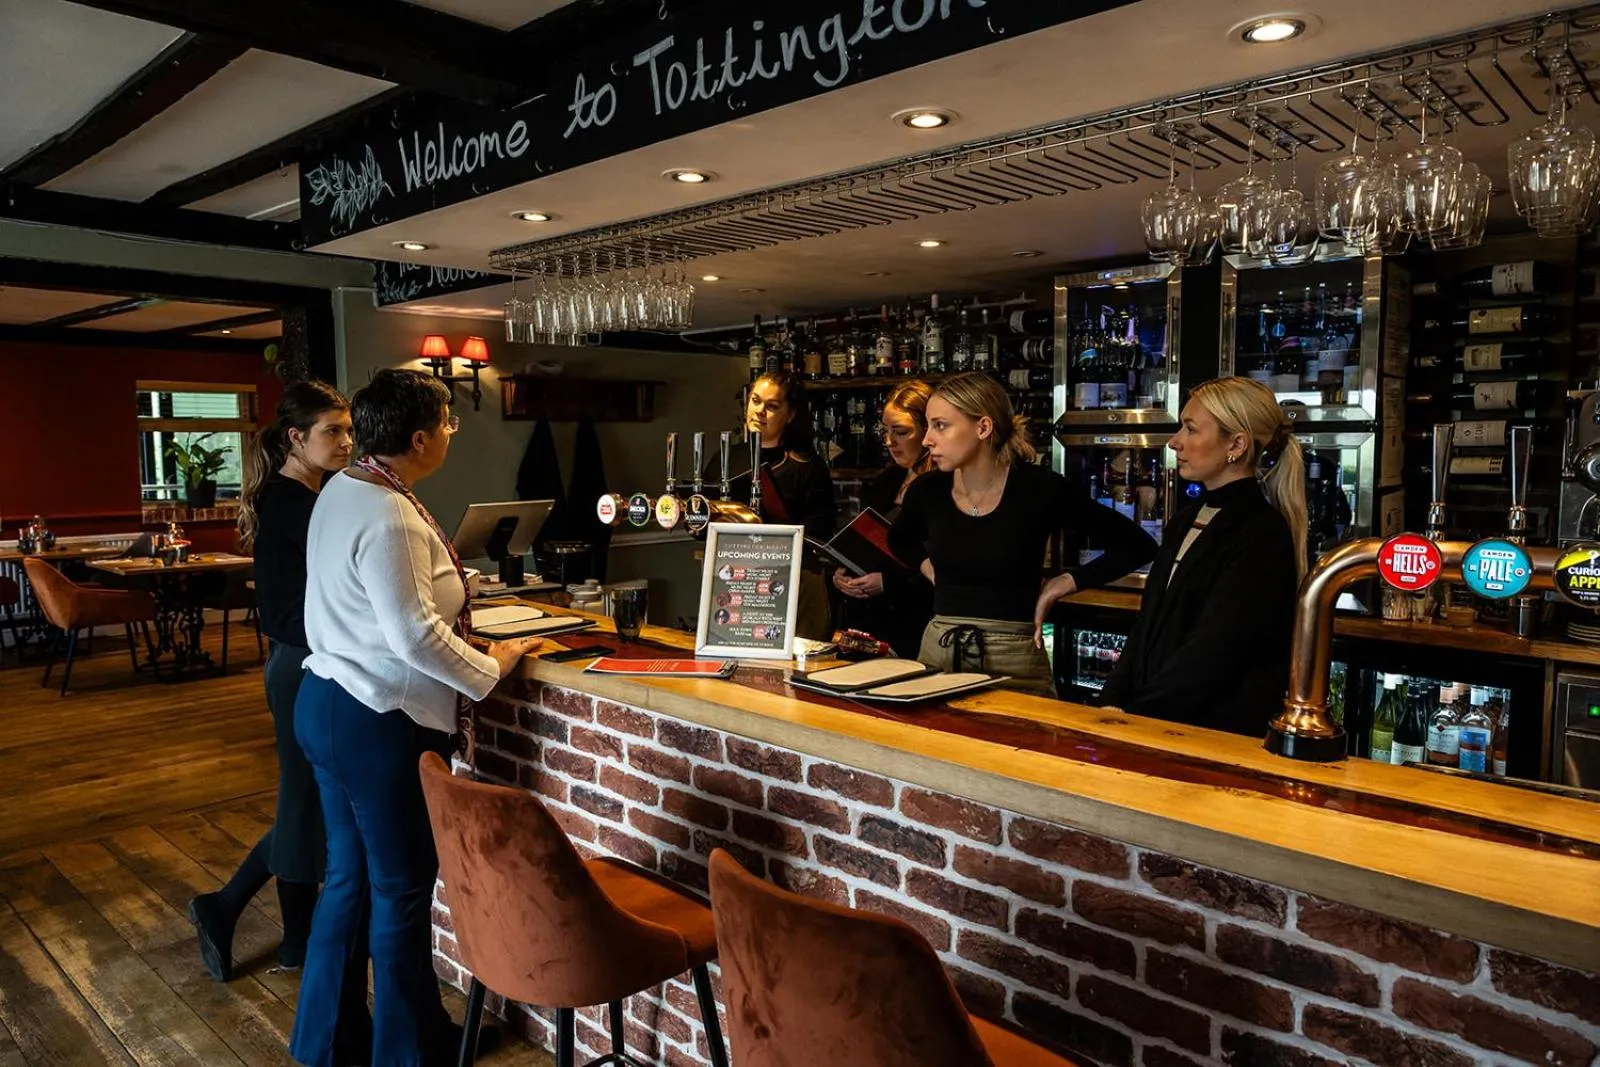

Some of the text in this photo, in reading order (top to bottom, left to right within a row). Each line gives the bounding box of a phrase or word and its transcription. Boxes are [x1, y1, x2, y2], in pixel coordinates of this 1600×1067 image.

[399, 121, 531, 193] Welcome
[563, 73, 617, 139] to
[717, 551, 791, 561] UPCOMING EVENTS
[1392, 552, 1427, 576] HELLS
[1481, 550, 1513, 558] CAMDEN
[1480, 559, 1514, 582] PALE
